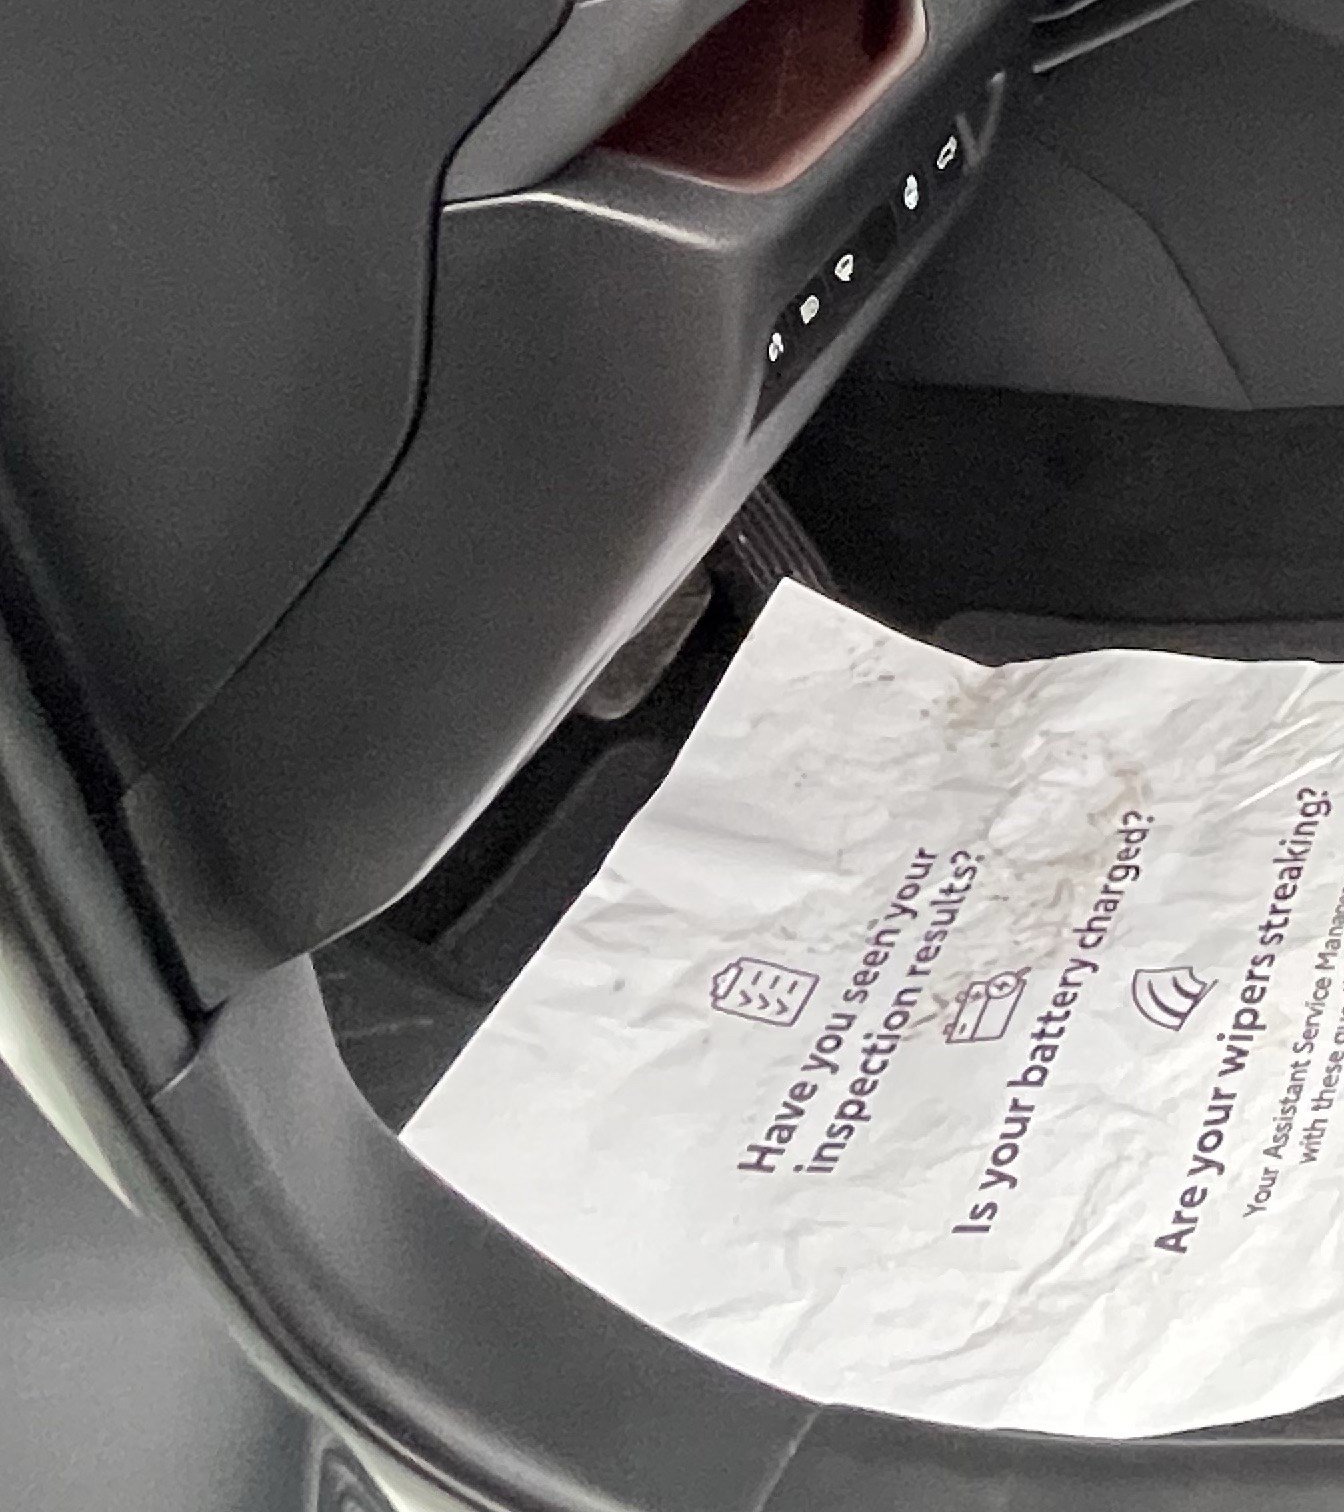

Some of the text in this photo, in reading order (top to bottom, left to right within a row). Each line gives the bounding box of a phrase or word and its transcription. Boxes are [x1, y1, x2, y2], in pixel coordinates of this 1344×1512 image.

[737, 846, 938, 1174] Have you seen your
[792, 850, 986, 1175] inspection results?
[951, 809, 1156, 1234] Is your battery charged?
[1154, 786, 1332, 1256] Are your wipers streaking?
[1243, 1168, 1278, 1219] Your
[1262, 1058, 1308, 1162] Assistant
[1292, 974, 1332, 1057] Service
[1298, 1119, 1330, 1165] with
[1314, 1051, 1341, 1118] these
